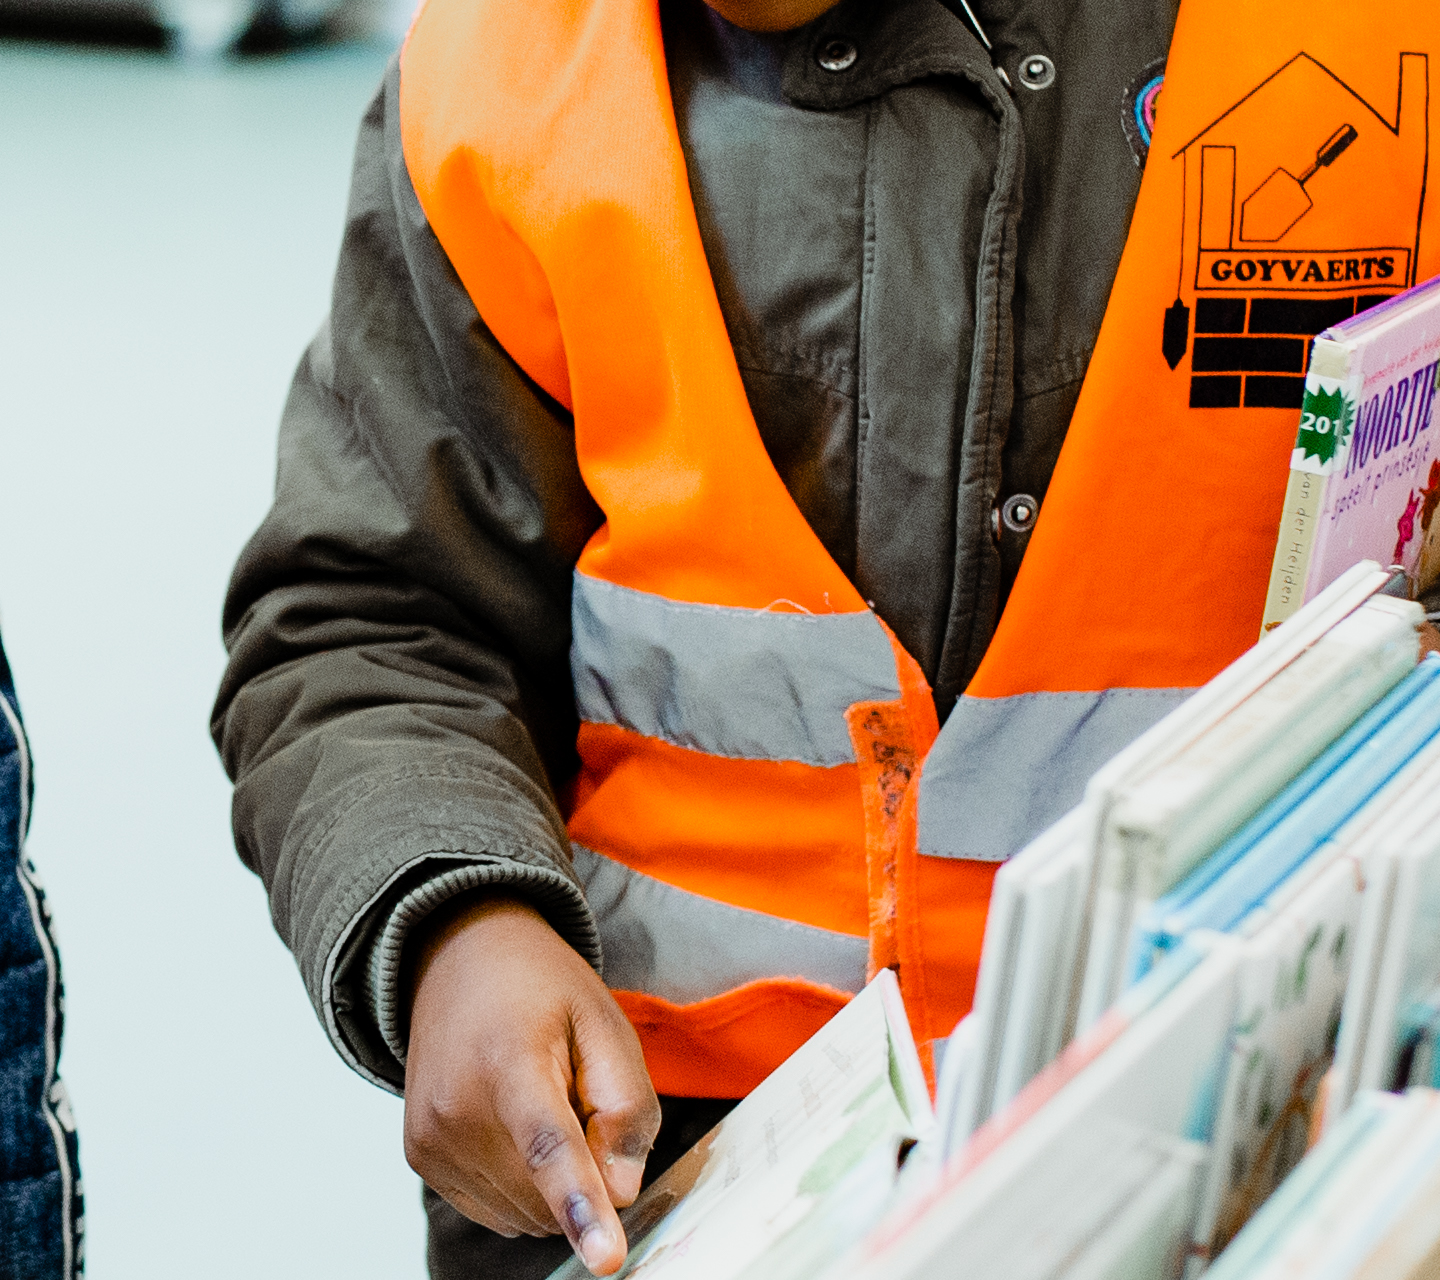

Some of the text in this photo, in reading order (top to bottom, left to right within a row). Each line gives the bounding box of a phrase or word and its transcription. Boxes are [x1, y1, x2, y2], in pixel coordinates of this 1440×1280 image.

[1211, 257, 1395, 282] GOYVAERTS
[1344, 359, 1439, 479] NOORTJE
[1279, 472, 1312, 605] van der Heijden
